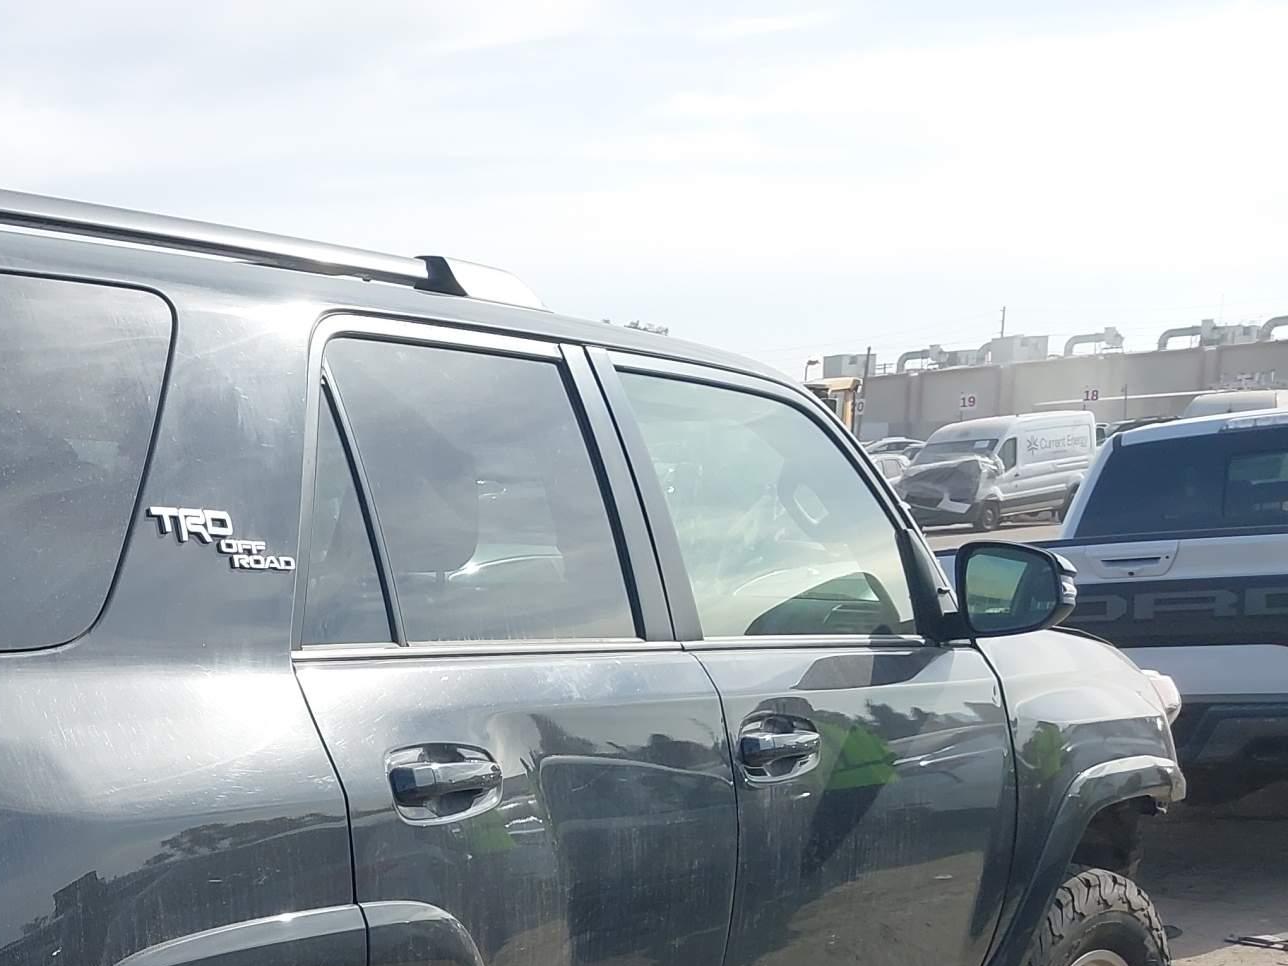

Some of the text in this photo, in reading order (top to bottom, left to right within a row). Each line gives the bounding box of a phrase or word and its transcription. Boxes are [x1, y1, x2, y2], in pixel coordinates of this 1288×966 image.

[960, 396, 976, 408] 19
[1083, 390, 1099, 401] 18
[146, 506, 234, 543] TRD
[217, 539, 266, 554] OFF
[231, 554, 296, 571] ROAD
